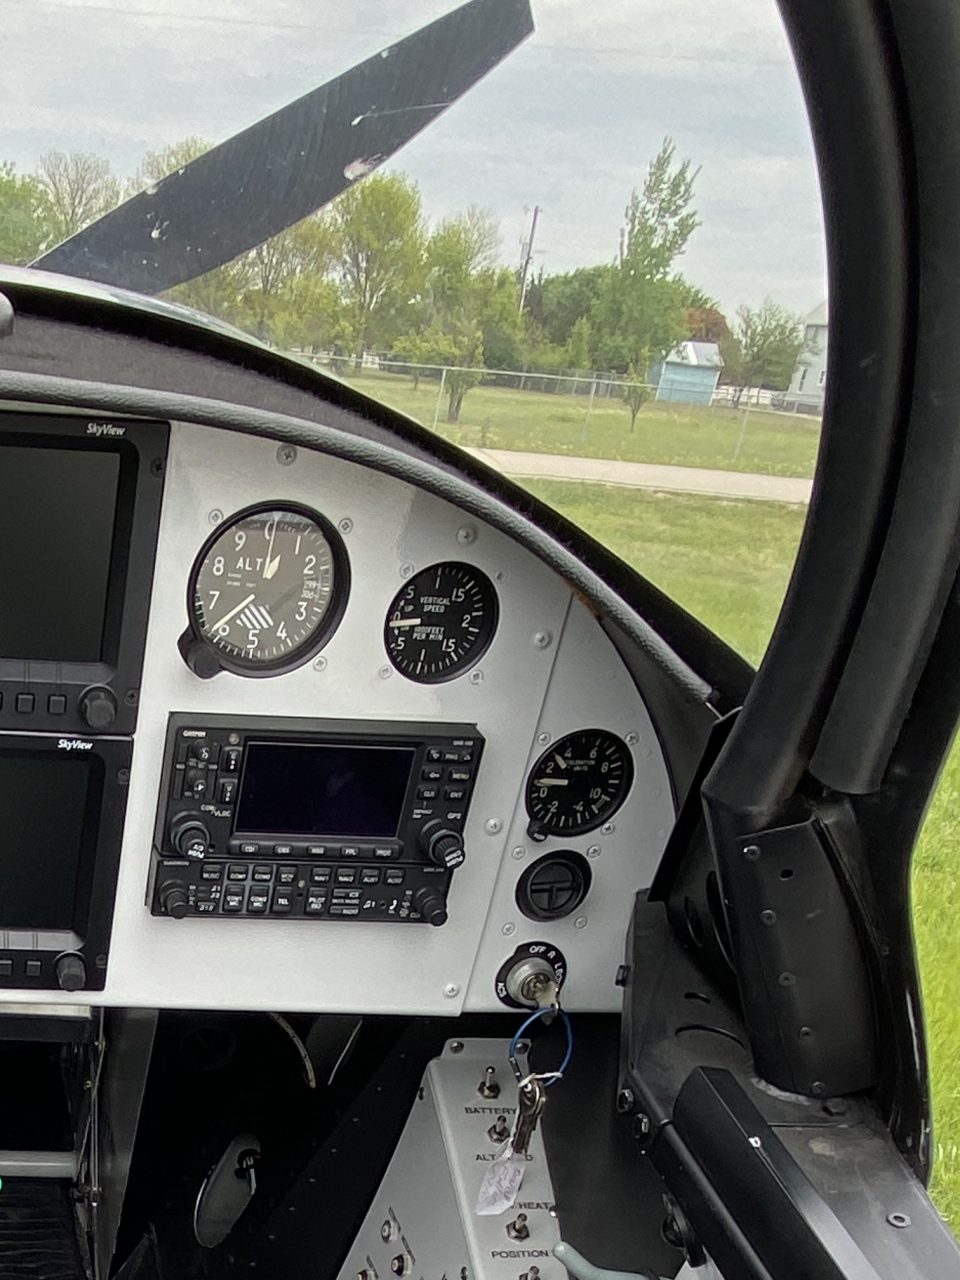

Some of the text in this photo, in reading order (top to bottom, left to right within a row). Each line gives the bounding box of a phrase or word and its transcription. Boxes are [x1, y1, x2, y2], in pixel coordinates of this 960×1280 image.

[86, 422, 126, 437] SkyView
[234, 531, 247, 552] 9
[212, 556, 225, 576] 8
[236, 557, 263, 571] ALT
[303, 555, 316, 575] 2
[209, 591, 220, 610] 7
[295, 601, 307, 620] 3
[461, 615, 471, 628] 2
[276, 621, 288, 640] 4
[247, 630, 260, 648] 5
[58, 738, 93, 751] SkyView
[546, 762, 554, 774] 2
[529, 945, 547, 954] OFF
[465, 1107, 517, 1115] BATTERY
[518, 1202, 549, 1210] HEAT
[492, 1250, 549, 1259] POSITION
